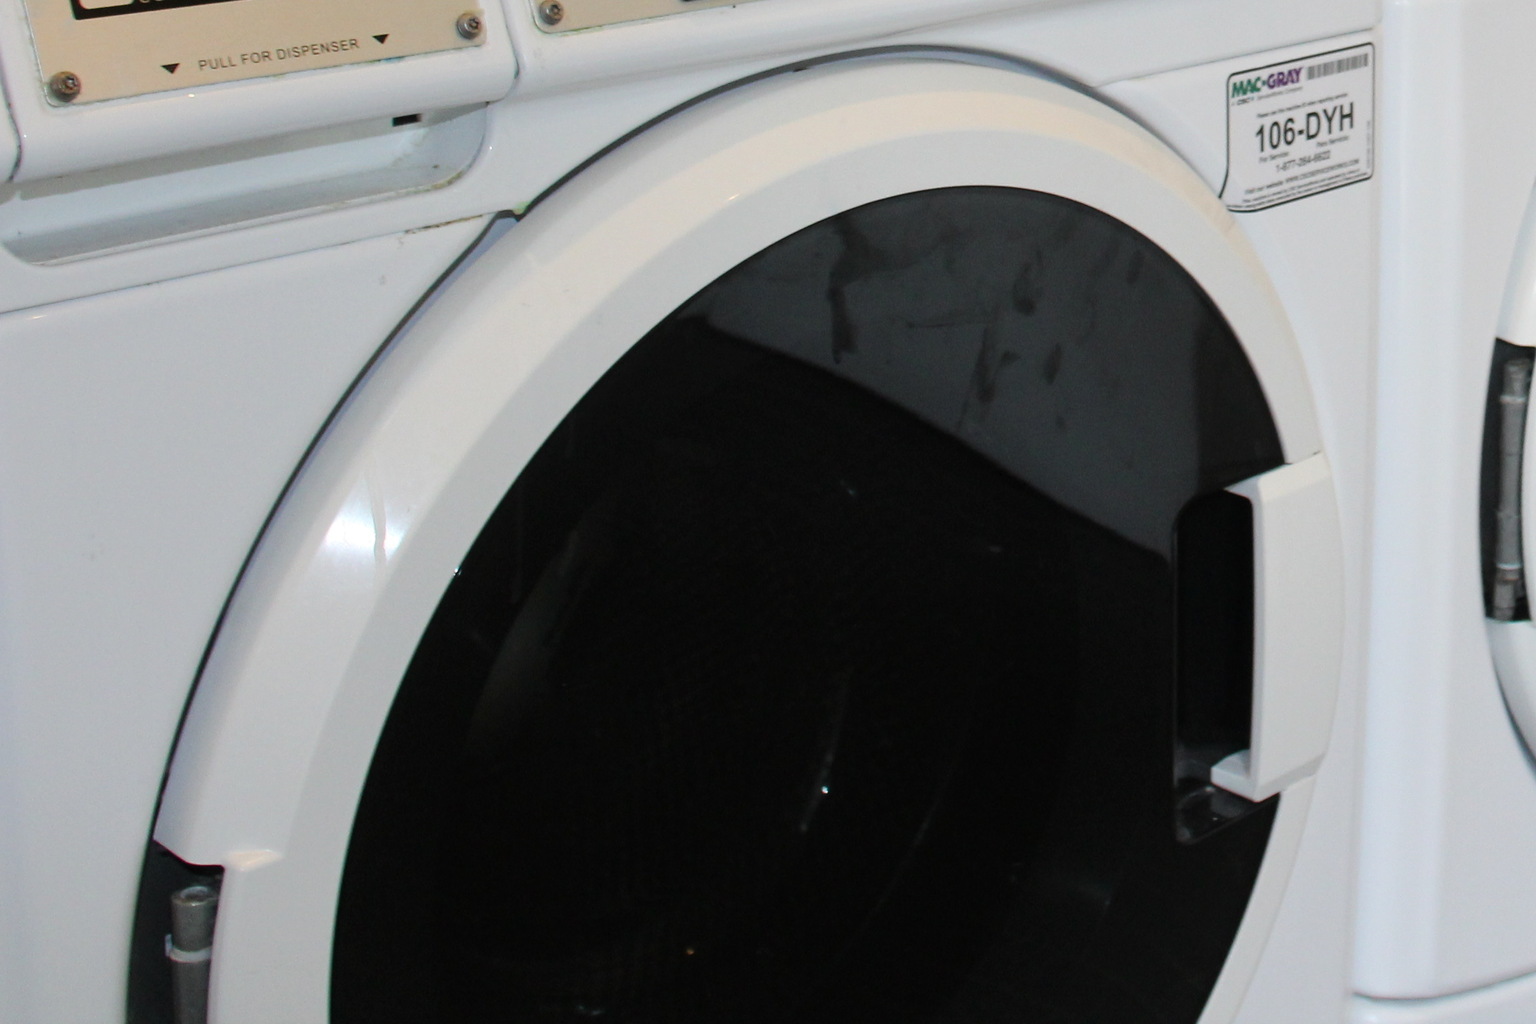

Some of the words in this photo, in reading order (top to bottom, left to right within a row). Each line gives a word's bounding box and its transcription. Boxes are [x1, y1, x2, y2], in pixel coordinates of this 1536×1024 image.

[198, 56, 237, 71] PULL
[240, 50, 272, 64] FOR
[275, 38, 361, 61] DISPENSER
[1255, 101, 1355, 153] 106-DYH
